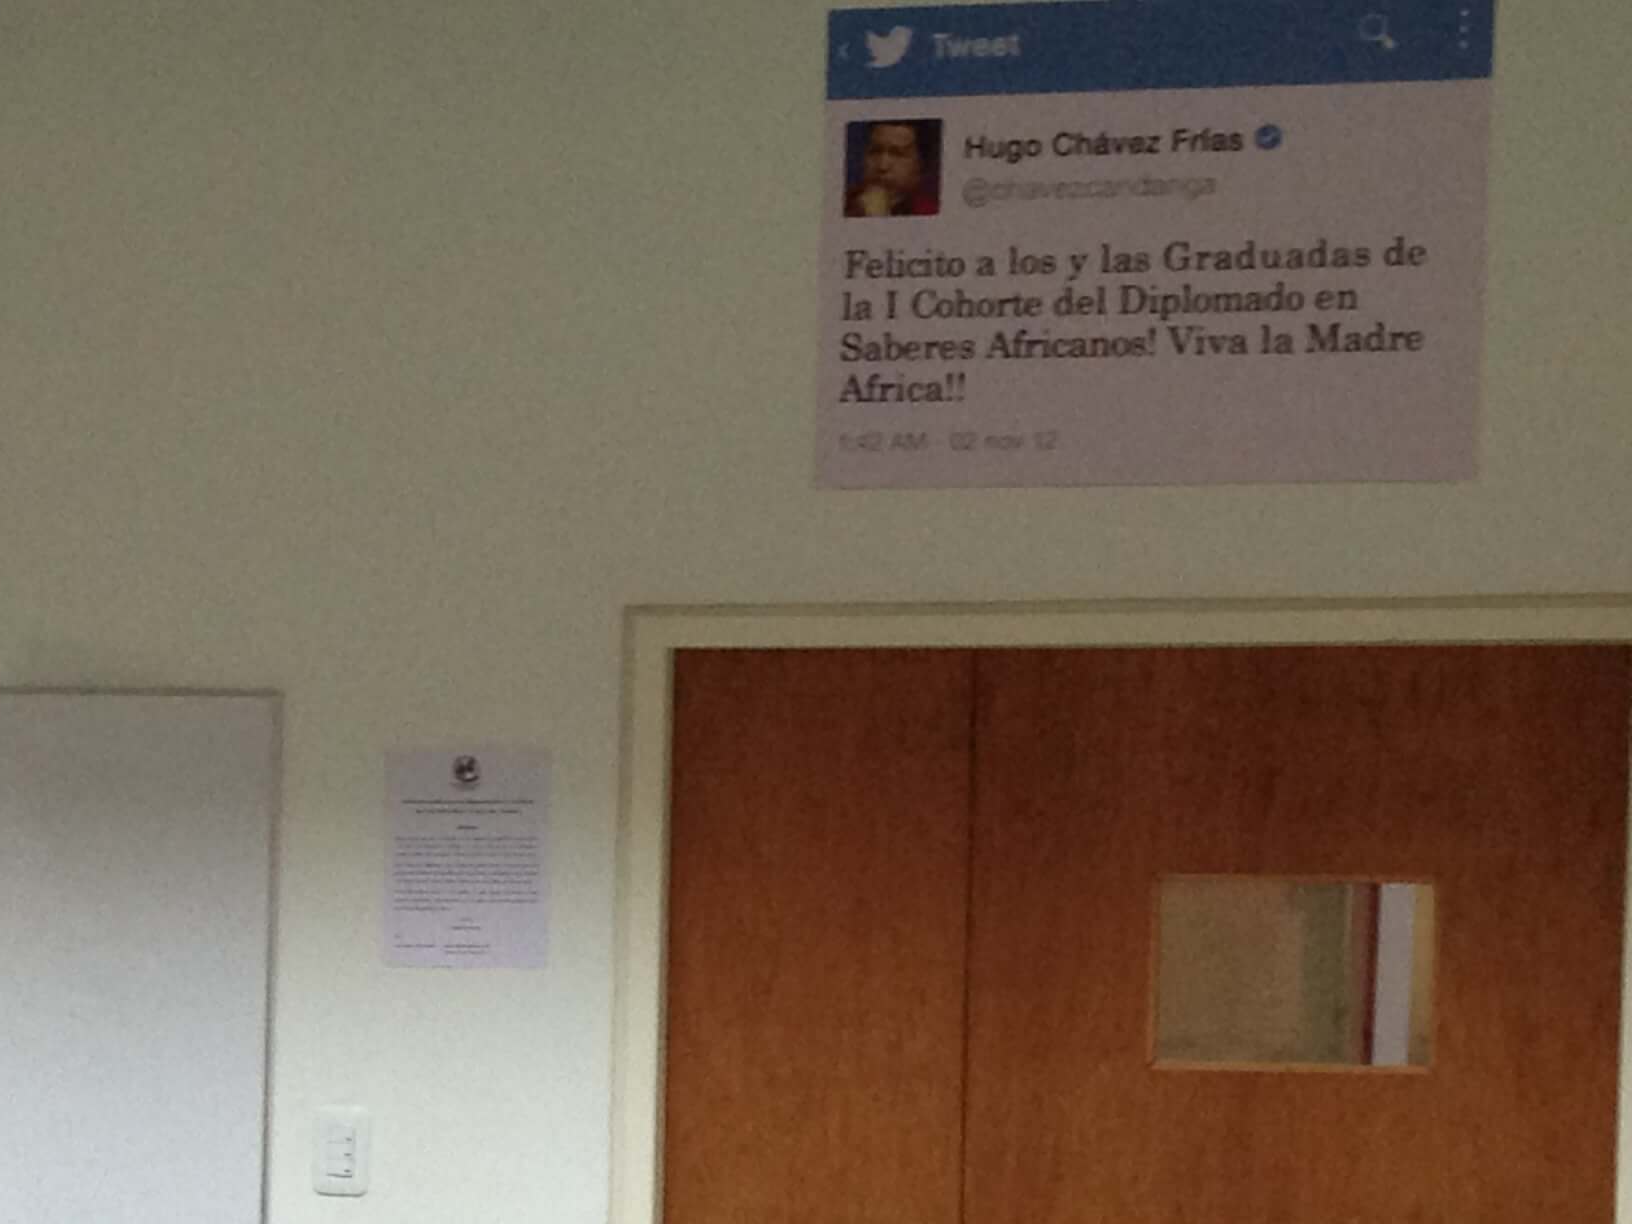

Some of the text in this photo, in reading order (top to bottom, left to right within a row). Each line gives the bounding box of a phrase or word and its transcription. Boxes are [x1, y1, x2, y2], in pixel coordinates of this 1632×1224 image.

[932, 30, 1022, 60] Tweet
[965, 125, 1244, 164] Hugo Chávez Frías
[845, 235, 1428, 281] Felicito a los y las Graduadas de
[842, 290, 872, 322] la
[912, 287, 1043, 320] Cohorte
[1053, 284, 1108, 317] del
[1119, 280, 1305, 322] Diplomado
[1314, 287, 1359, 311] en
[839, 320, 1426, 363] Saberes Africanos! Viva la Madre
[839, 370, 967, 403] Africa!!
